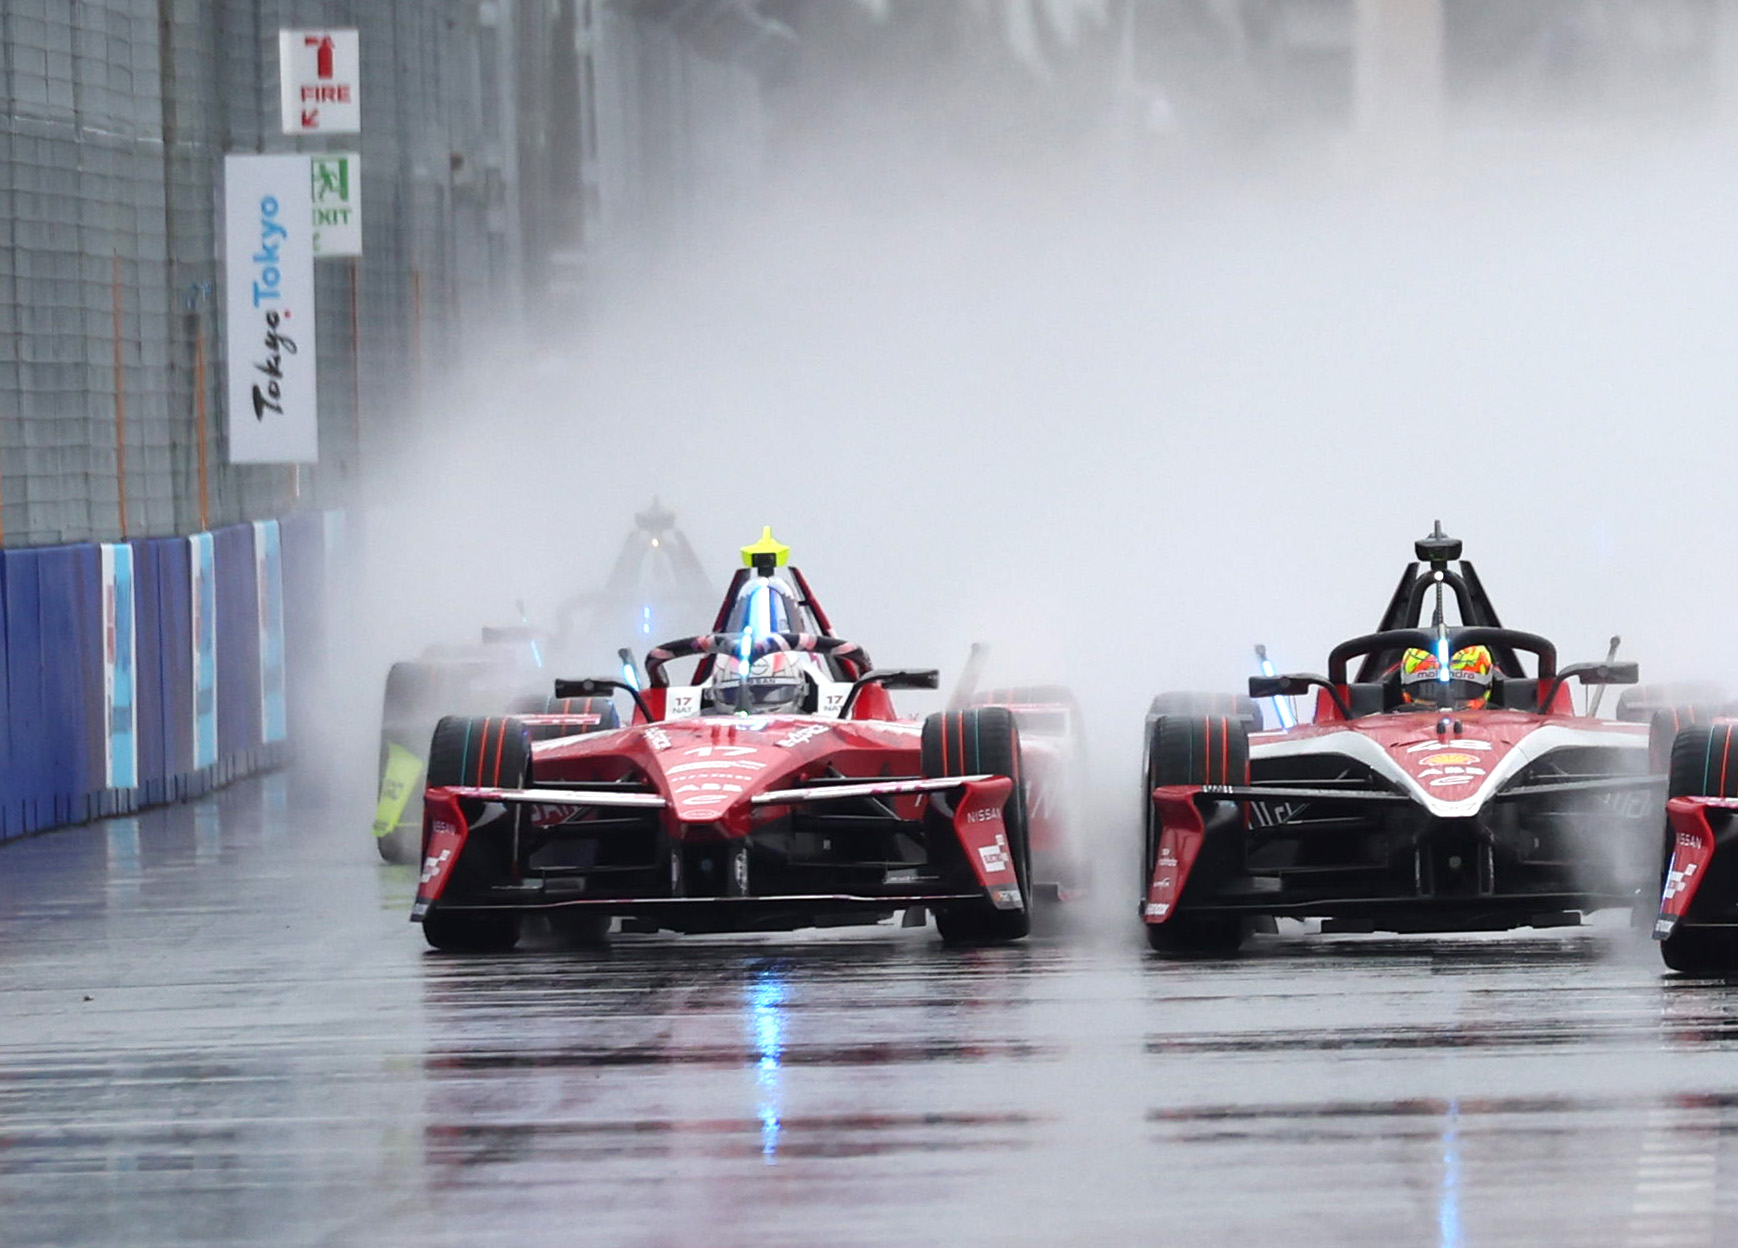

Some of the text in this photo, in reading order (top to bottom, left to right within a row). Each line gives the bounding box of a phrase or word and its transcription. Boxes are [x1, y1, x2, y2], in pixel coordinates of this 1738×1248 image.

[301, 85, 351, 103] FIRE
[252, 195, 297, 423] Tokyo Tokyo
[675, 697, 692, 706] 17
[825, 695, 843, 705] 17
